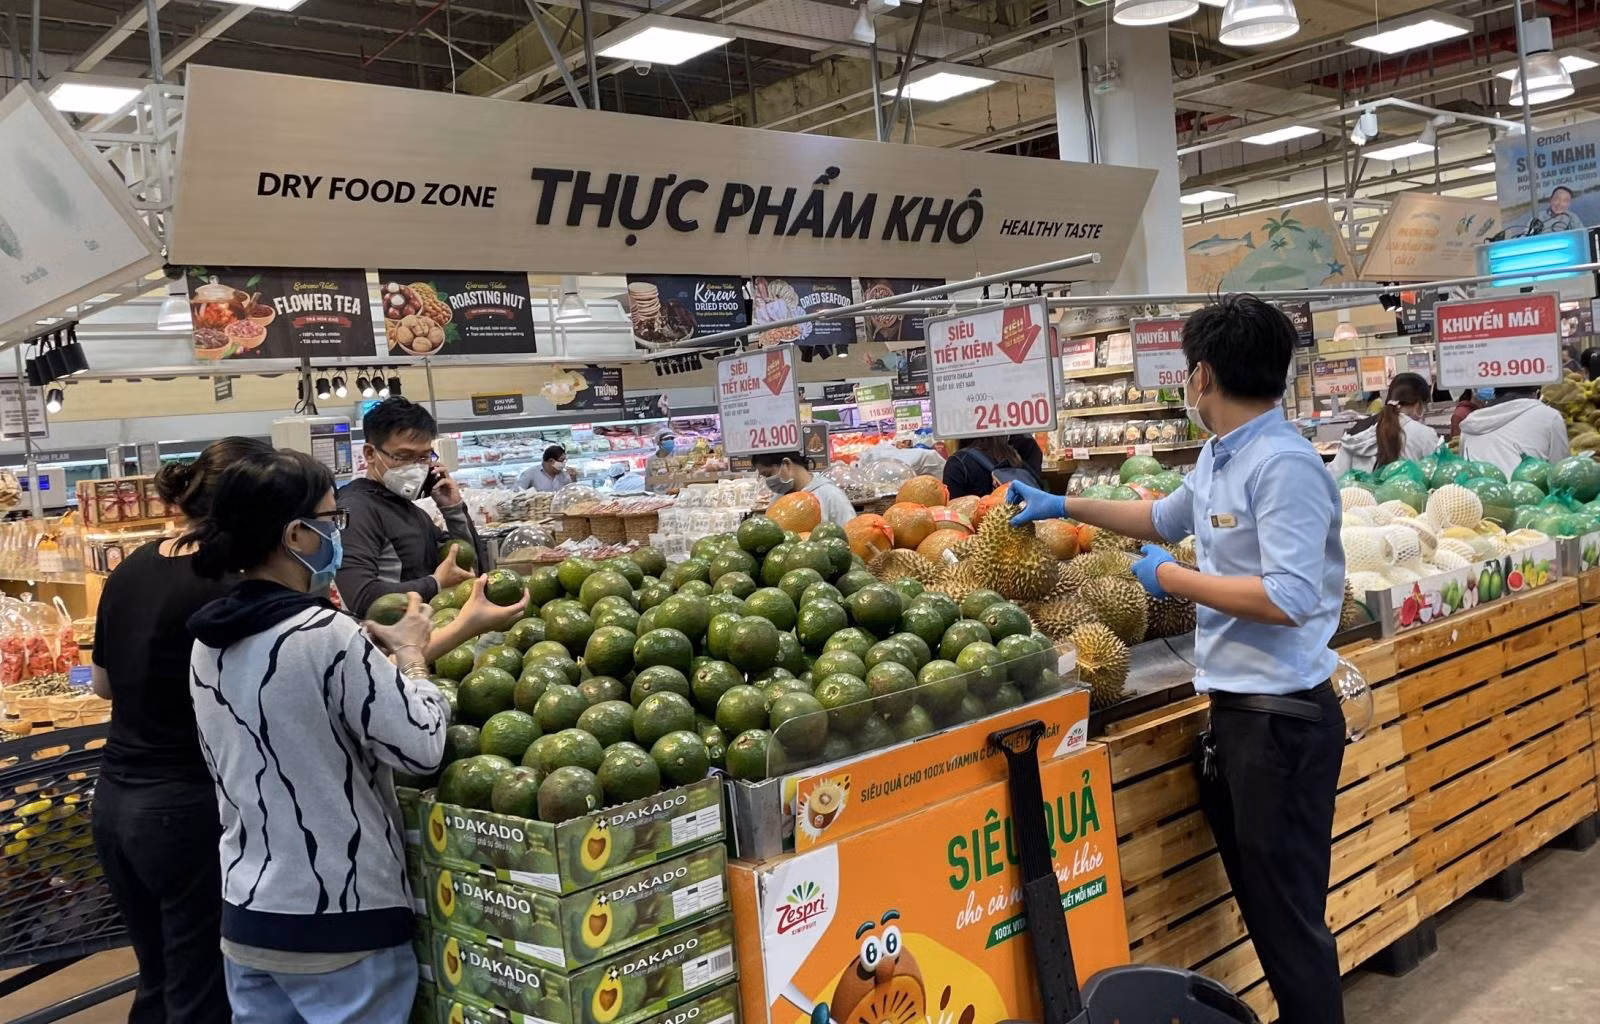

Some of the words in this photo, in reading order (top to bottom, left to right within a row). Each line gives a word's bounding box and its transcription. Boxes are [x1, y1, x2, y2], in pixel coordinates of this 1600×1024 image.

[1537, 131, 1571, 147] emart
[257, 172, 322, 200] DRY
[329, 177, 415, 204] FOOD
[421, 183, 497, 208] ZONE
[531, 167, 709, 246] THỰC
[714, 165, 877, 239] PHẨM
[882, 188, 985, 244] KHÔ
[1000, 219, 1062, 239] HEALTHY
[1064, 223, 1103, 240] TASTE
[273, 293, 332, 315] FLOWER
[334, 294, 361, 315] TEA
[449, 290, 500, 310] ROASTING
[502, 292, 525, 310] NUT
[694, 281, 737, 303] Korean
[800, 292, 820, 309] DRIED
[820, 291, 851, 307] SEAFOOD
[695, 302, 718, 311] DRIED
[718, 302, 738, 311] FOOD
[948, 320, 974, 341] SIÊU
[1442, 308, 1503, 334] KHUYẾN
[1507, 306, 1539, 328] MÃI
[1136, 326, 1169, 345] KHUYẾN
[934, 342, 958, 364] TIẾT
[961, 339, 994, 363] KIỆM
[730, 360, 748, 376] SIÊU
[1477, 357, 1545, 378] 39.900
[722, 378, 738, 395] TIẾT
[740, 375, 760, 394] KIỆM
[1329, 383, 1357, 393] 24.900
[974, 398, 1049, 430] 24.900
[749, 424, 798, 449] 24.900
[860, 783, 882, 802] SIÊU
[883, 773, 902, 795] QUẢ
[903, 770, 922, 787] CHO
[924, 762, 945, 780] 100%
[946, 750, 978, 772] VITAMIN
[980, 748, 985, 760] C
[612, 795, 687, 826] DAKADO
[454, 816, 524, 842] DAKADO
[612, 866, 688, 901] DAKADO
[462, 882, 531, 914] DAKADO
[956, 890, 983, 930] cho
[994, 922, 1012, 941] 100%
[1087, 880, 1104, 898] NGÀY
[776, 893, 826, 935] Zespri
[623, 938, 698, 975] DAKADO
[469, 952, 540, 988] DAKADO
